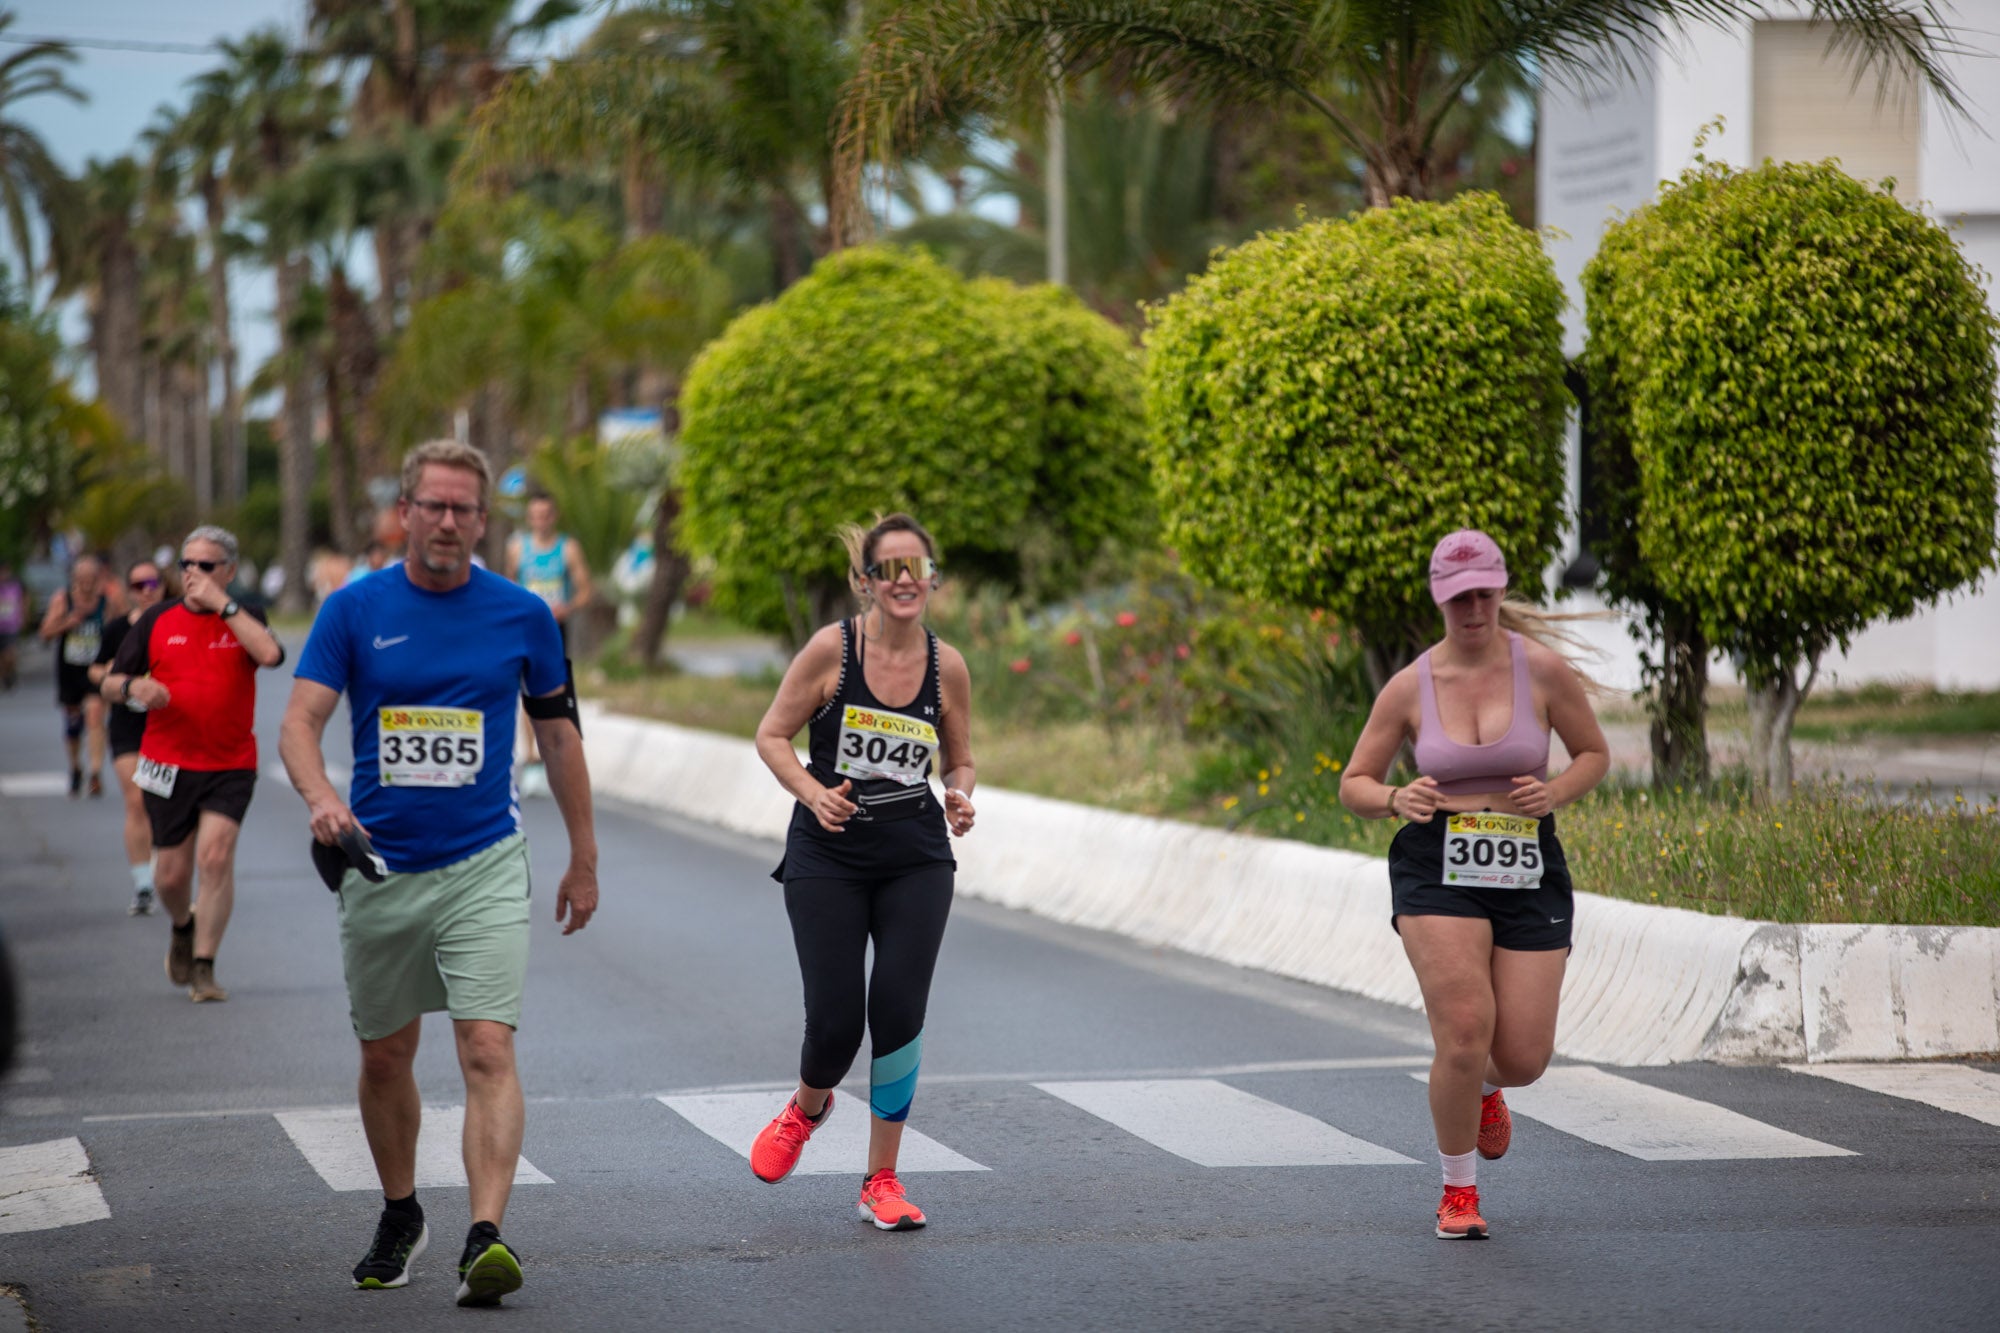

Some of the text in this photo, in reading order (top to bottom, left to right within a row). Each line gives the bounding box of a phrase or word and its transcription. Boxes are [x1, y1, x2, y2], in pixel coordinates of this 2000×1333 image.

[858, 712, 874, 726] 38
[383, 736, 478, 766] 3365
[843, 732, 929, 769] 3049
[1461, 816, 1477, 829] 38
[1448, 837, 1539, 870] 3095
